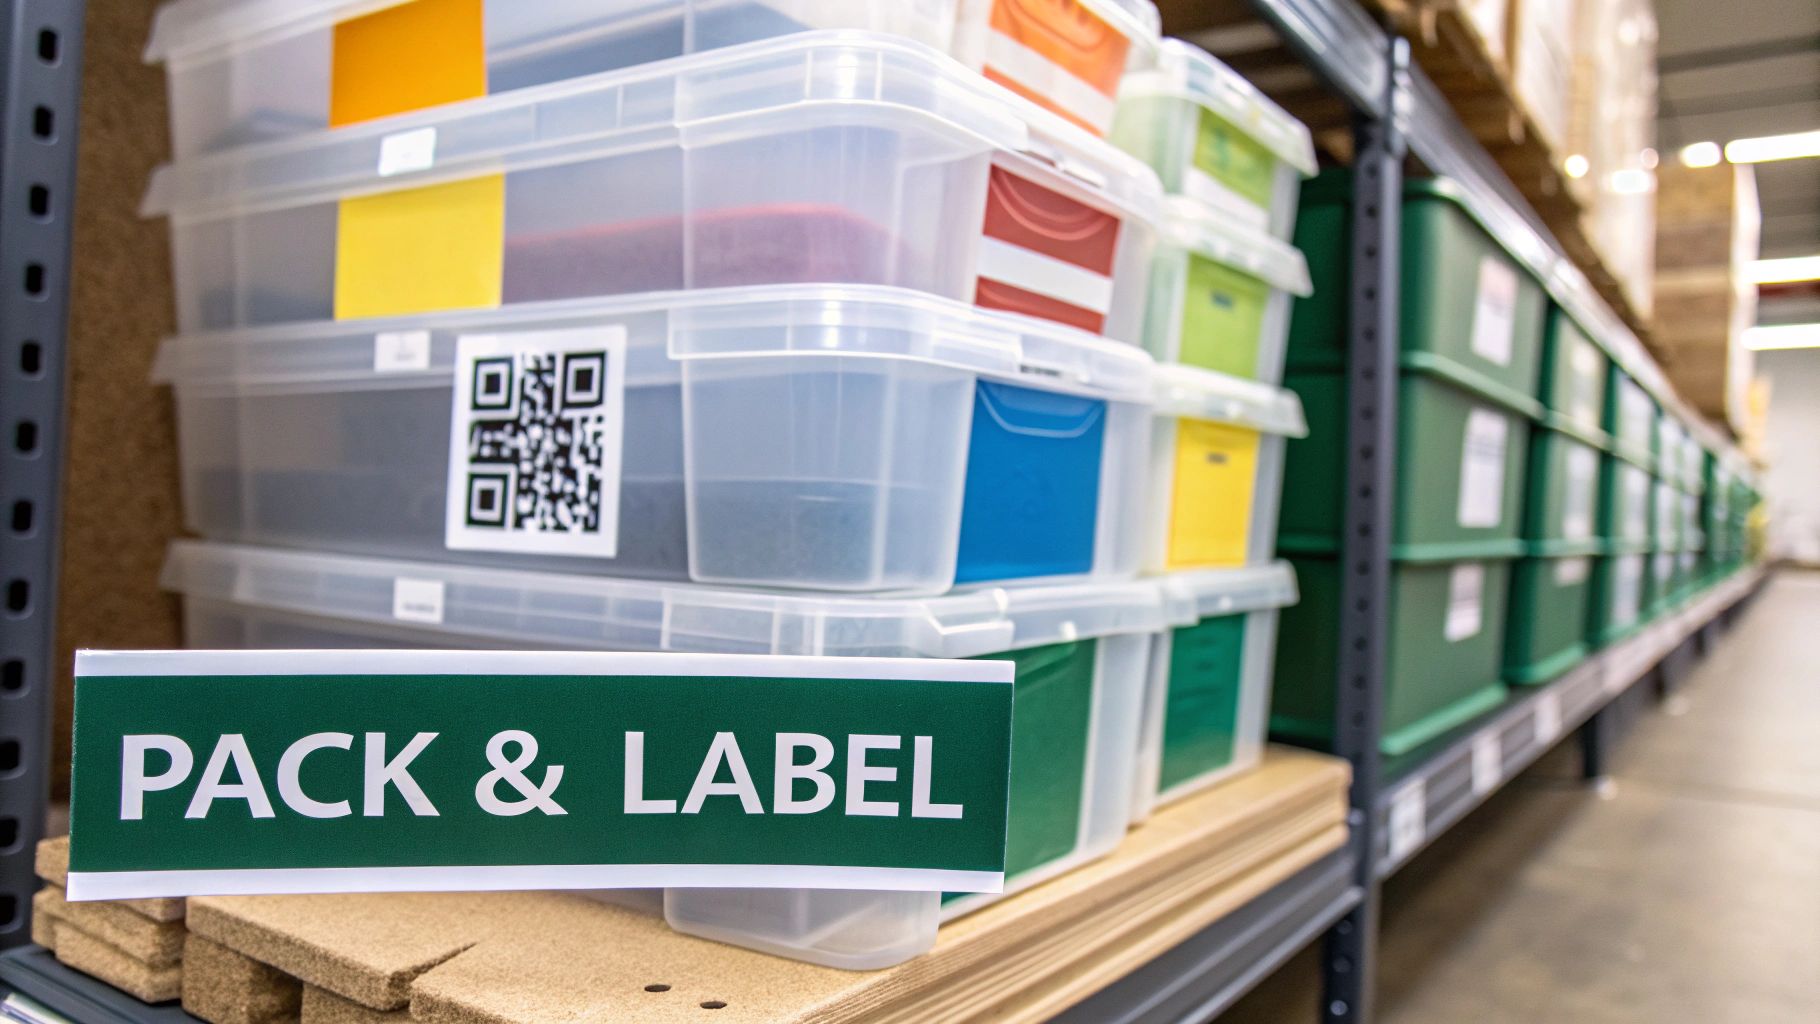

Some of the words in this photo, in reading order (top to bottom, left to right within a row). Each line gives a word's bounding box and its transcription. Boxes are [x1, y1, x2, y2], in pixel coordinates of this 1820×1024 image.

[120, 732, 440, 819] PACK
[475, 730, 568, 816] &
[624, 732, 964, 818] LABEL
